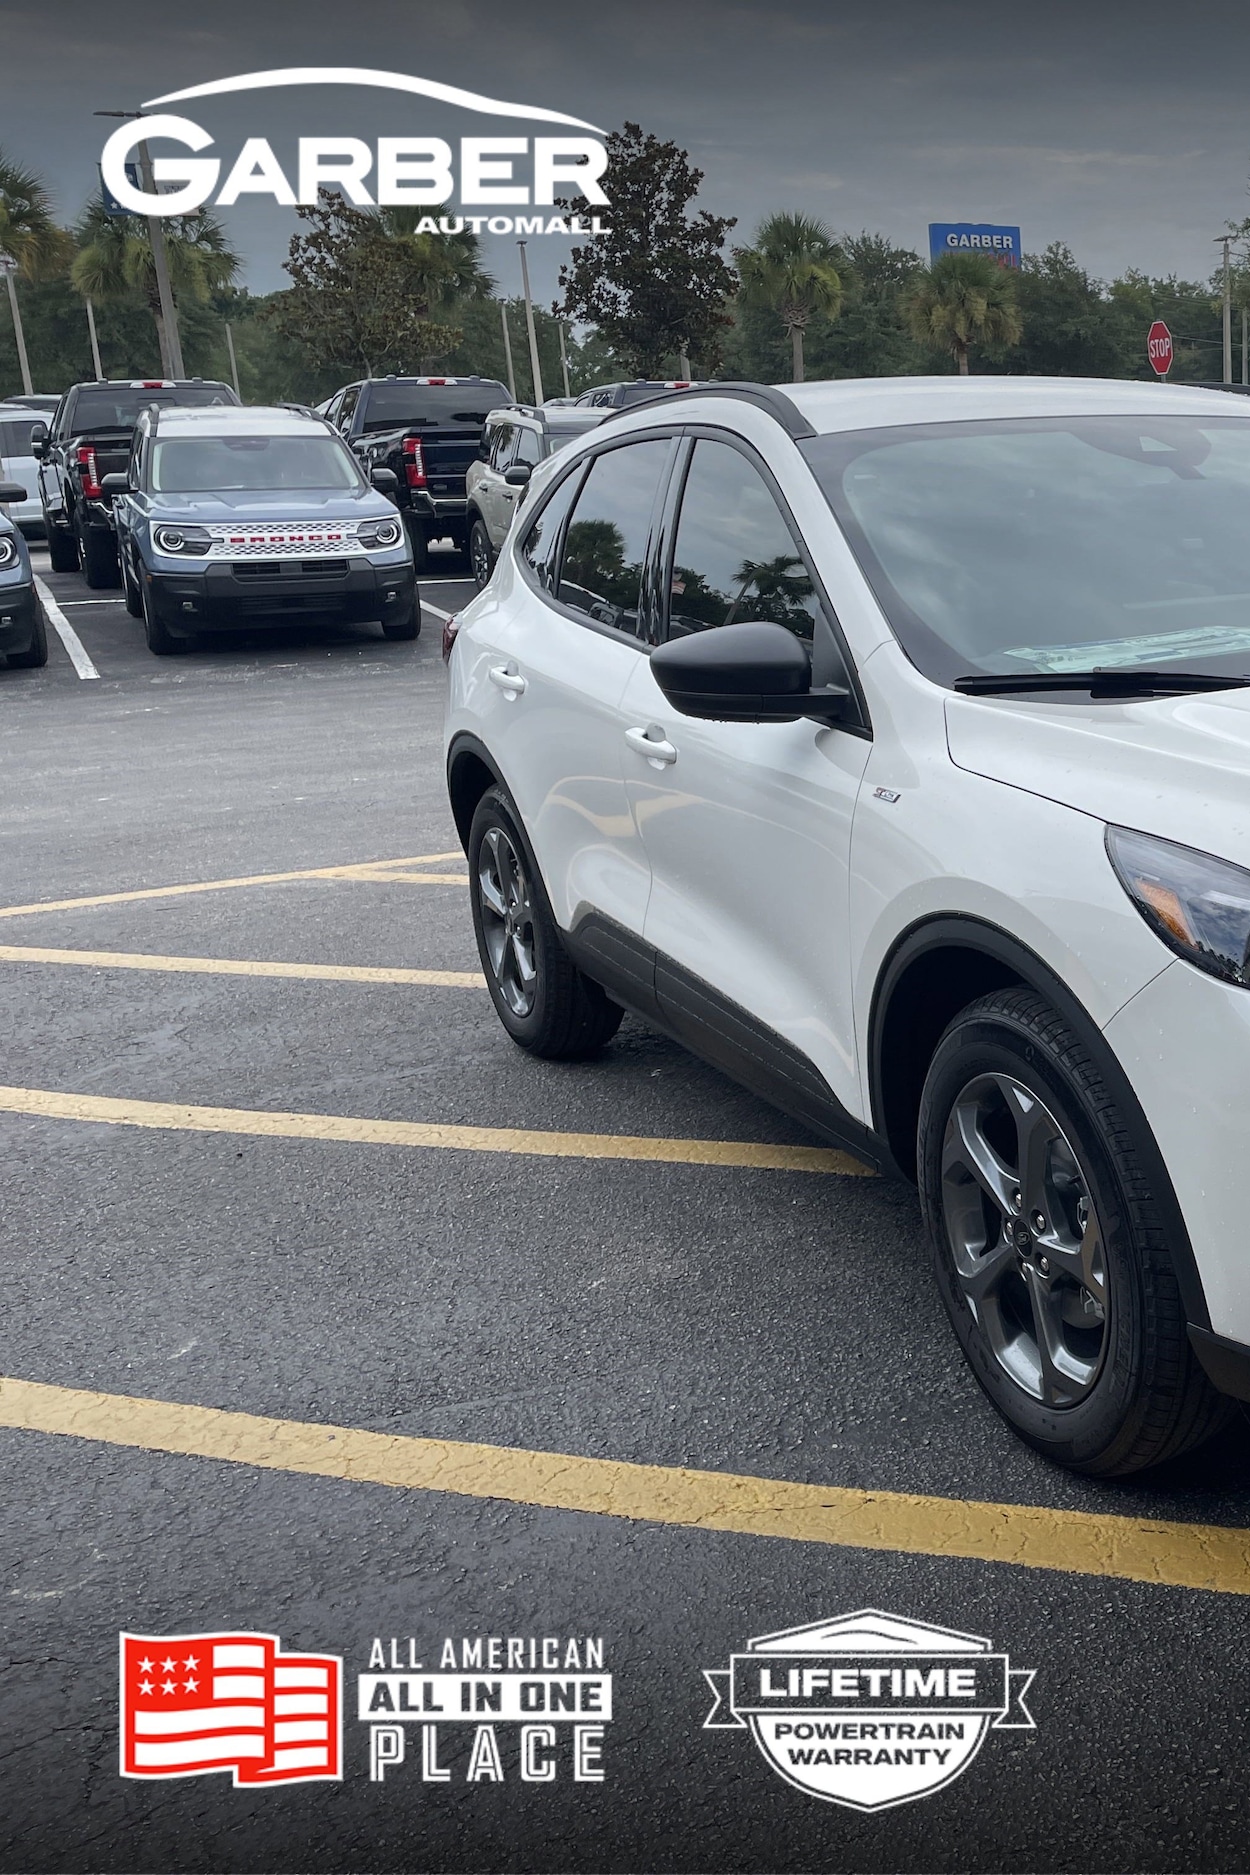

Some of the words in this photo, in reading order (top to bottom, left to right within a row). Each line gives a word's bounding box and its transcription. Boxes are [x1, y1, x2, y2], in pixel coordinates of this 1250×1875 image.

[946, 233, 1013, 249] GARBER
[1149, 337, 1170, 359] STOP
[229, 533, 342, 544] BRONCO
